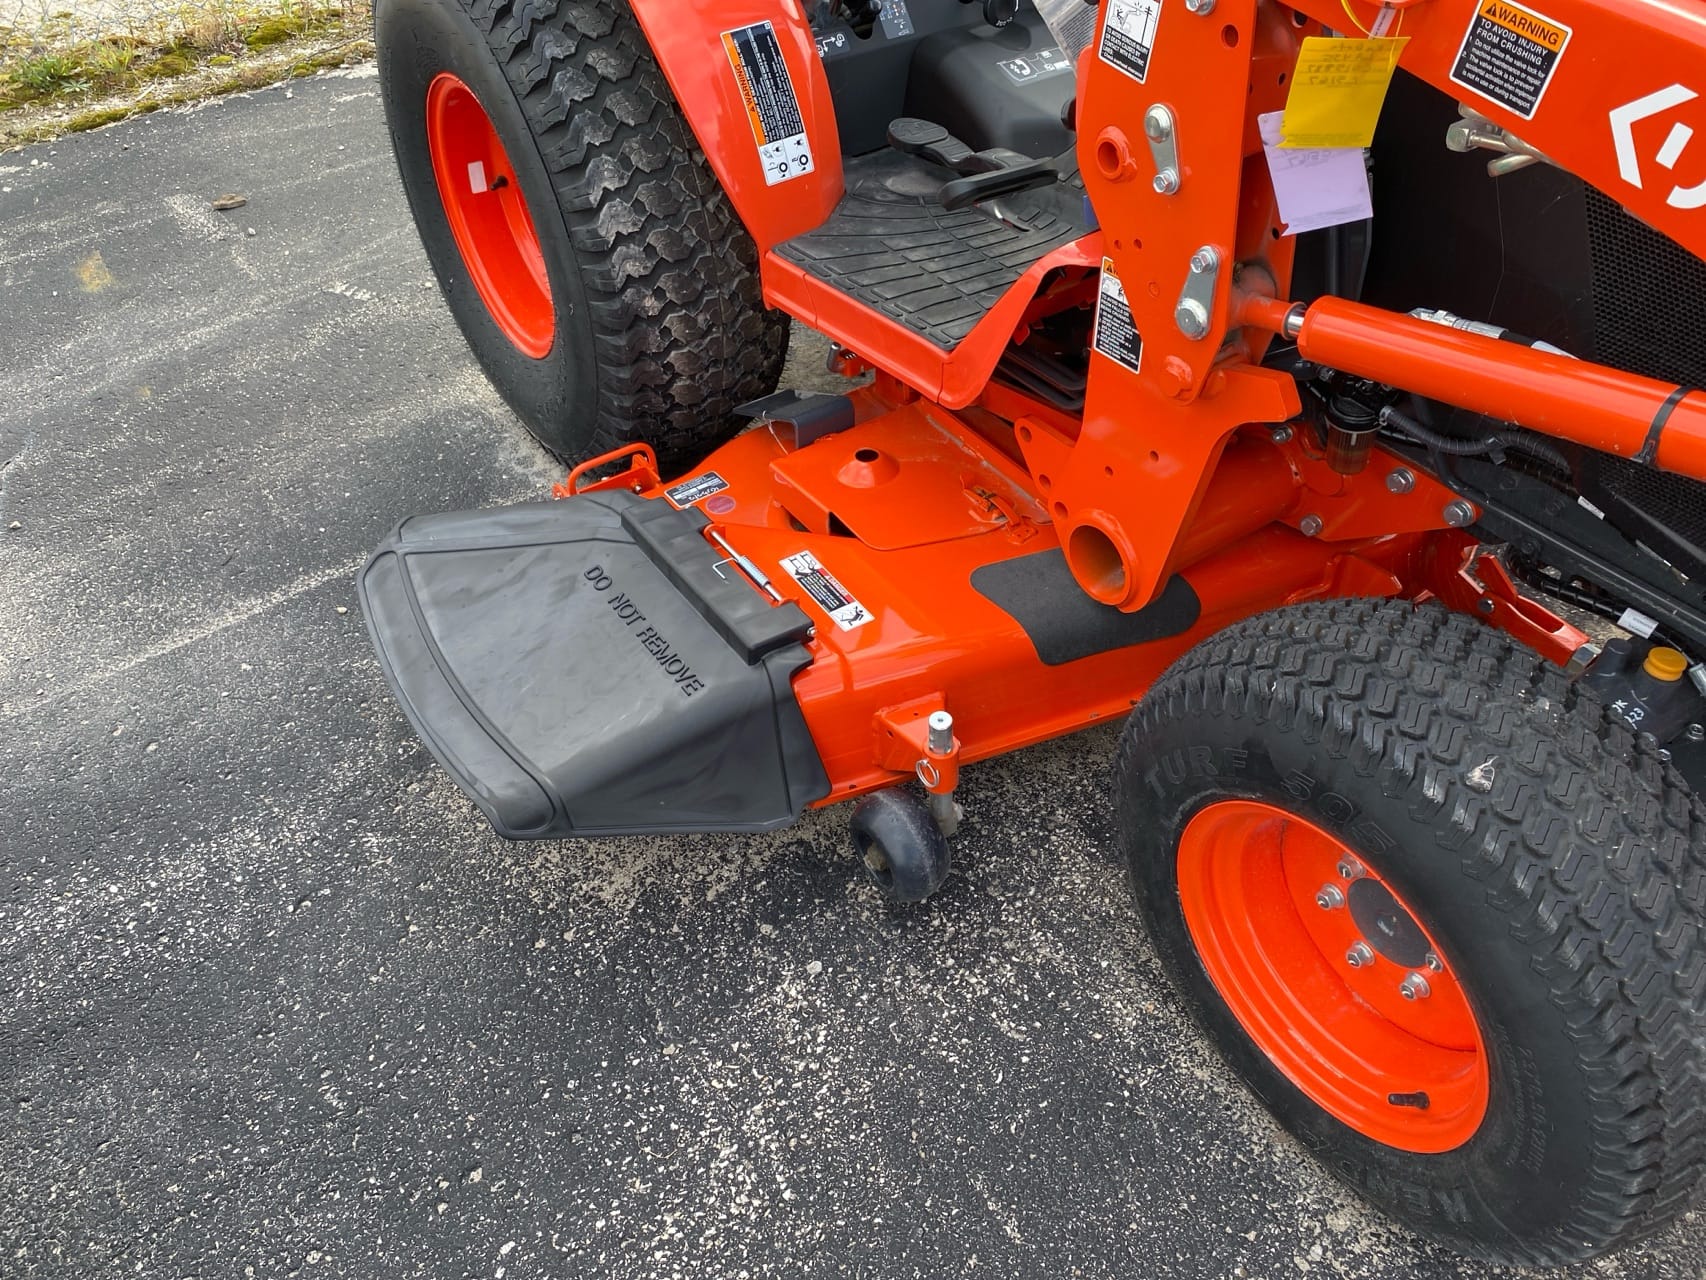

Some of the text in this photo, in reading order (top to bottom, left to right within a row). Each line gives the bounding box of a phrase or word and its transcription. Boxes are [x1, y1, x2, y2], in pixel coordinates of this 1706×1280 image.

[1480, 18, 1548, 56] TO AVOID INJURY
[1496, 7, 1560, 45] WARNING
[1474, 38, 1483, 47] Do
[1482, 42, 1491, 51] not
[1504, 53, 1514, 63] the
[1475, 26, 1500, 44] FROM
[1500, 38, 1543, 65] CRUSHING
[734, 63, 753, 106] WARNING
[1466, 71, 1475, 79] not
[1479, 78, 1488, 87] use
[1488, 82, 1494, 90] or
[1493, 85, 1509, 98] during
[1468, 54, 1479, 63] The
[1478, 59, 1493, 70] valve
[1492, 66, 1503, 76] lock
[1502, 71, 1509, 79] is
[1508, 74, 1515, 82] to
[583, 564, 706, 697] DO NOT REMOVE
[1144, 744, 1248, 799] TURF
